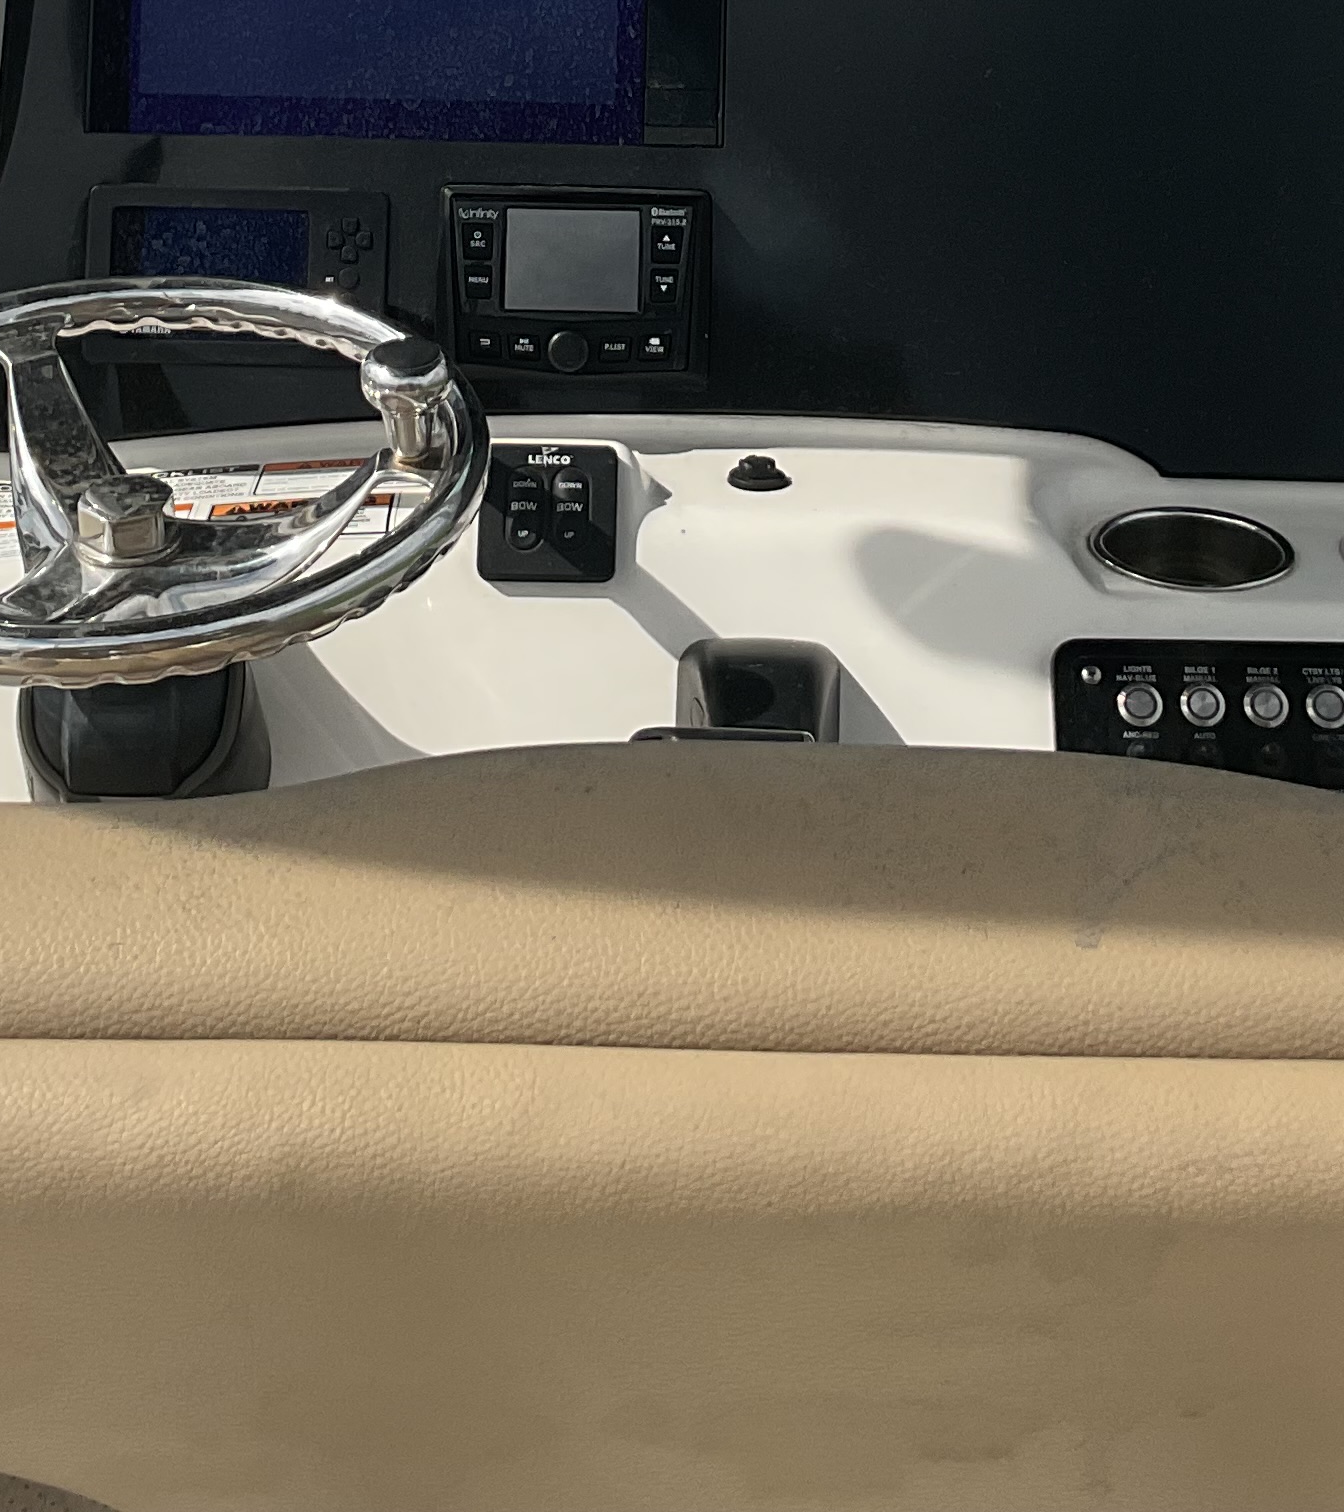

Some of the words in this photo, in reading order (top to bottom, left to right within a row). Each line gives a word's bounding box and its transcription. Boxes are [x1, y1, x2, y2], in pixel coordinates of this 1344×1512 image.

[656, 243, 676, 251] TUNE
[655, 275, 675, 284] TUNE
[514, 344, 535, 352] MUTE
[644, 345, 665, 354] VIEW
[528, 454, 571, 466] LENCO
[513, 480, 537, 488] DOWN
[558, 481, 582, 489] DOWN
[510, 501, 537, 511] BOW
[556, 502, 583, 512] BOW
[517, 530, 529, 538] UP
[564, 531, 574, 539] UP
[1123, 665, 1152, 673] LIGHTS
